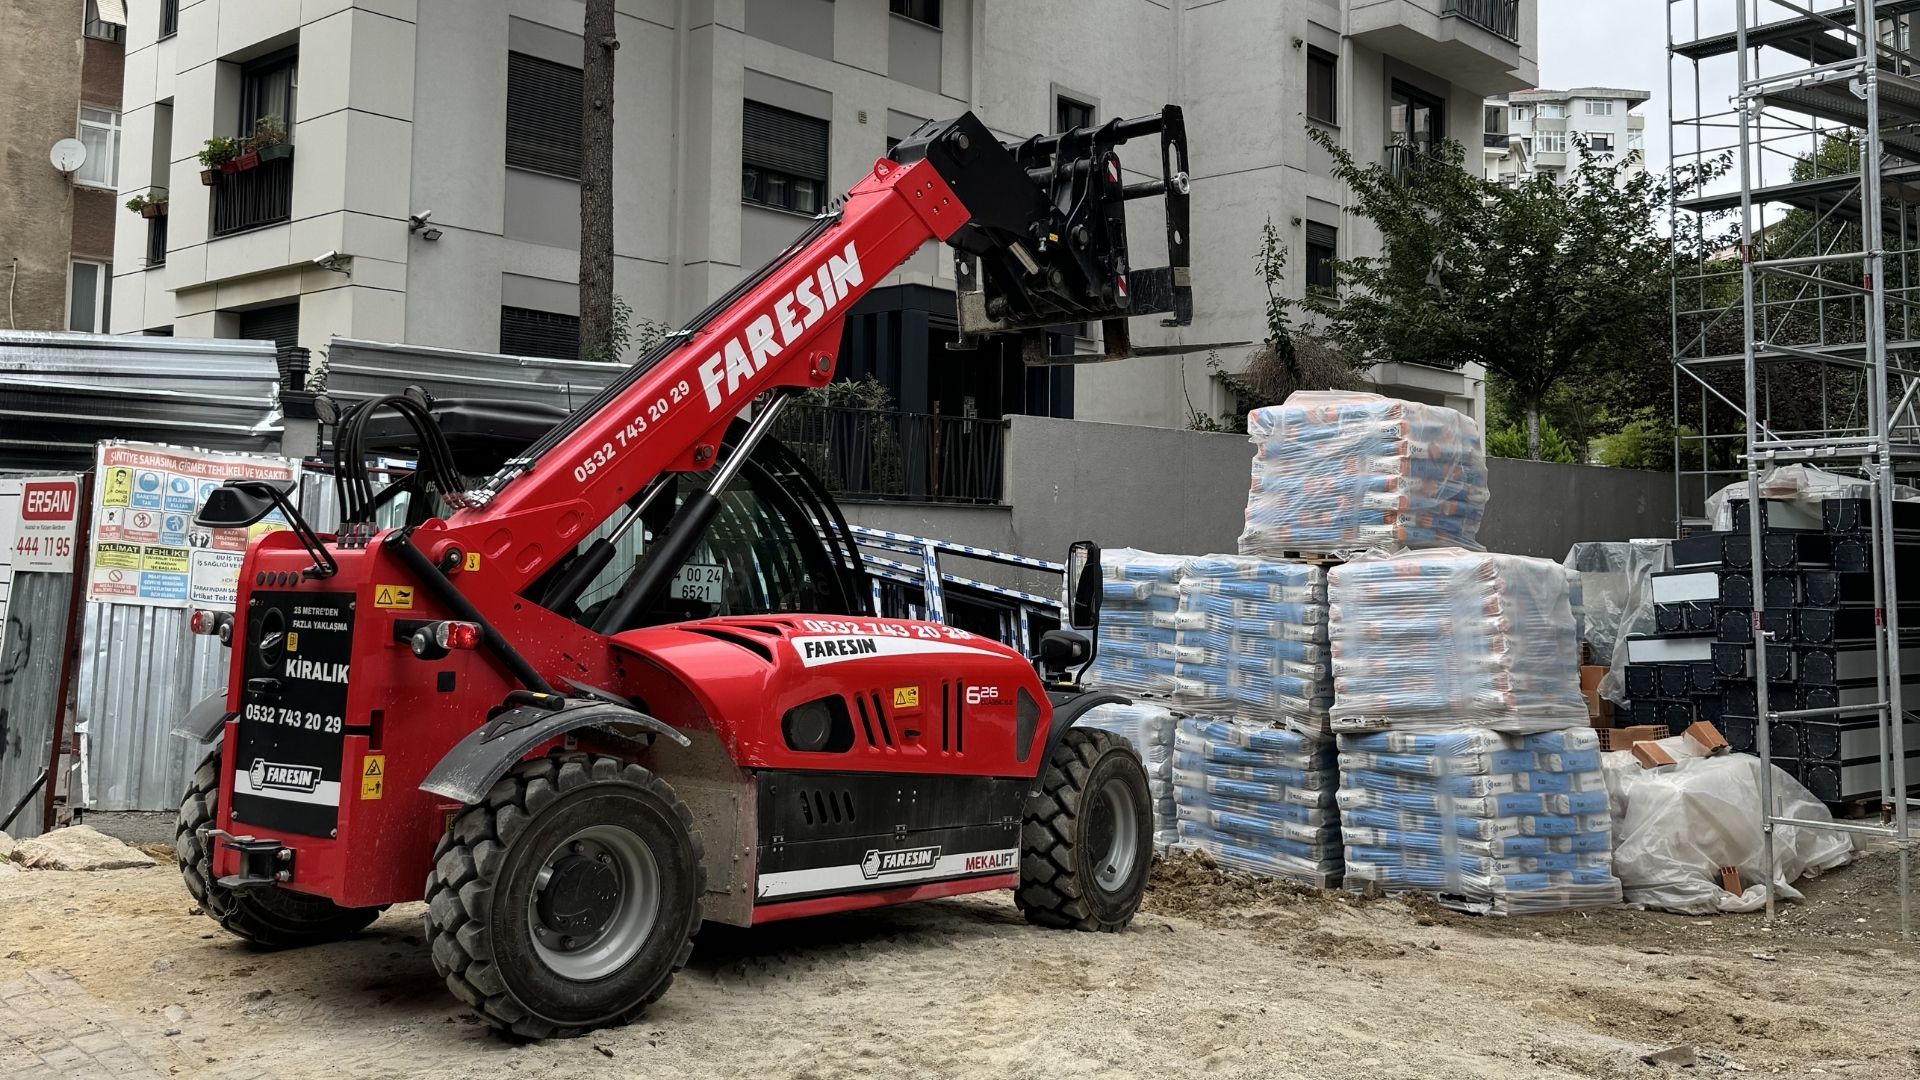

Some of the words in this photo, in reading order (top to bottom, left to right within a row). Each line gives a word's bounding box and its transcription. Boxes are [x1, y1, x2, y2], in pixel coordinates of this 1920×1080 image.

[698, 240, 864, 413] FARESIN
[574, 442, 616, 482] 0532
[616, 416, 647, 447] 743
[648, 398, 669, 422] 20
[669, 380, 690, 404] 29
[139, 455, 177, 470] SAHASINA
[208, 463, 245, 476] TEHLİKELİ
[245, 468, 254, 478] VE
[28, 490, 72, 512] ERSAN
[16, 537, 38, 556] 444
[100, 543, 138, 553] TALİMAT
[146, 547, 188, 557] TEHLİKE
[706, 569, 721, 583] 24
[193, 590, 213, 600] İrtibat
[682, 585, 710, 600] 6521
[302, 607, 339, 616] METRE'DEN
[292, 620, 312, 629] FAZLA
[313, 621, 348, 632] YAKLAŞMA
[803, 619, 865, 635] 0532
[864, 622, 910, 637] 743
[911, 625, 941, 638] 20
[804, 638, 877, 659] FARESIN
[285, 655, 350, 684] KİRALIK
[966, 686, 999, 704] 626
[246, 703, 275, 724] 0532
[279, 709, 301, 727] 743
[305, 712, 321, 731] 20
[324, 715, 342, 734] 29
[266, 766, 314, 786] FARESIN
[882, 850, 933, 869] FARESIN
[965, 851, 1017, 871] MEKALIFT
